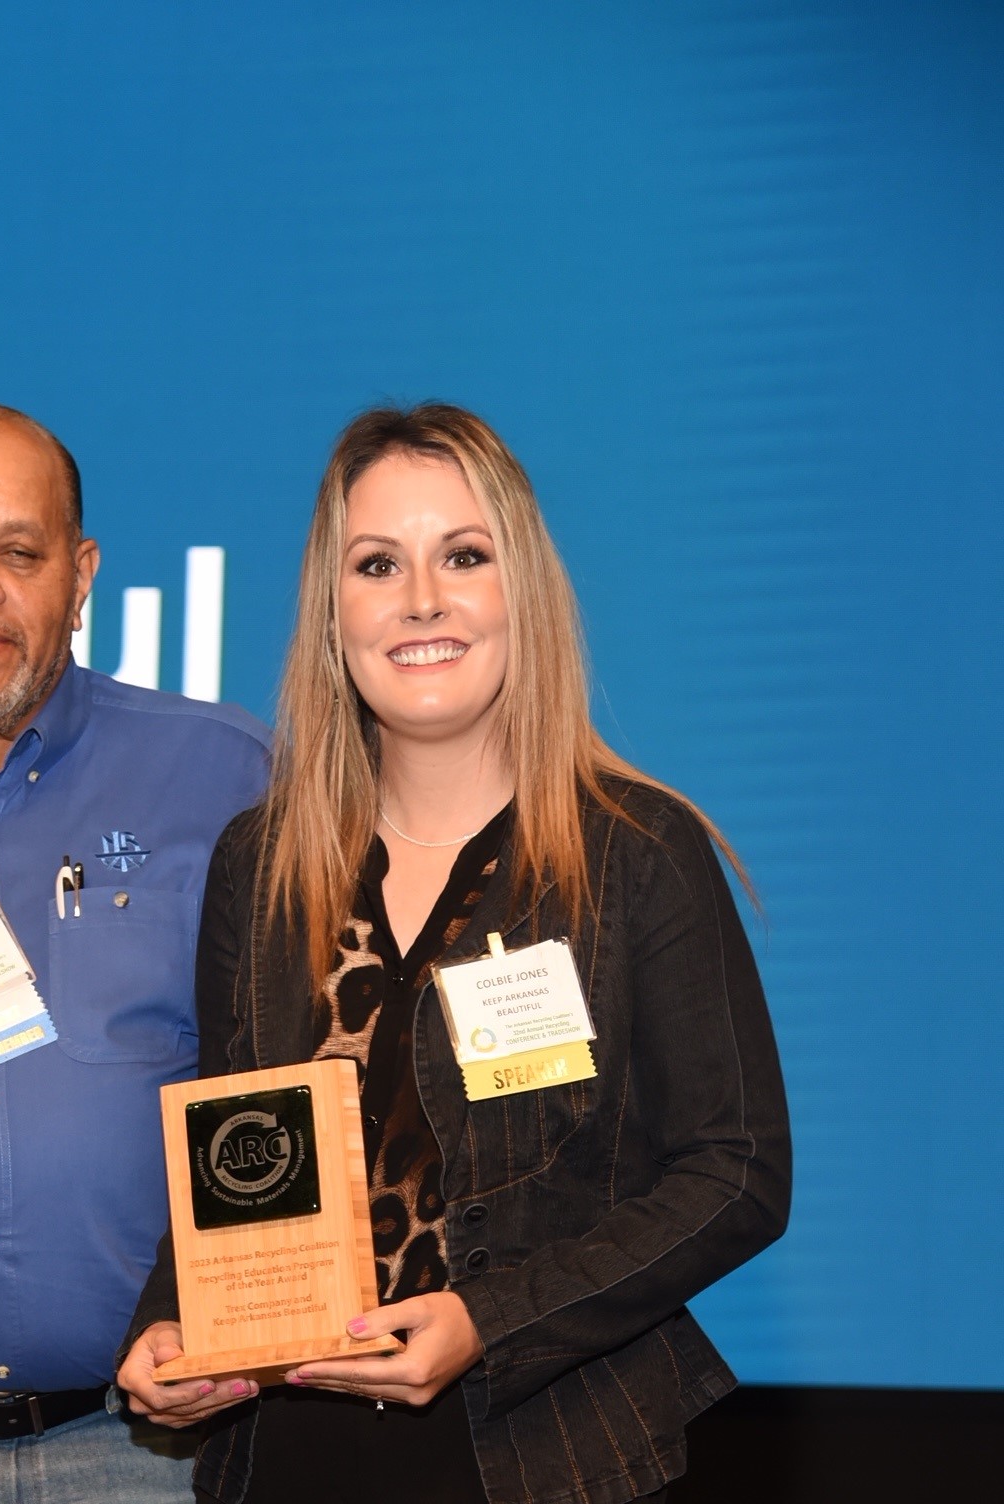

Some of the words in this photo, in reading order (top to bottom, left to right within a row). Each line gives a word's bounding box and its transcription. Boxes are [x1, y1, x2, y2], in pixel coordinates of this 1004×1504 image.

[477, 975, 513, 989] COLBIE
[516, 968, 548, 982] JONES
[483, 997, 502, 1006] KEEP
[506, 987, 549, 1002] ARKANSAS
[497, 1002, 542, 1016] BEAUTIFUL
[506, 1034, 540, 1045] CONFERENCE
[548, 1026, 580, 1037] TRADESHOW
[493, 1058, 569, 1089] SPEAKER
[230, 1115, 264, 1126] ARKANSAS
[215, 1132, 287, 1169] ARC
[197, 1146, 211, 1187] Advancing
[212, 1186, 253, 1206] Sustainable
[257, 1182, 290, 1205] Materials
[289, 1129, 305, 1180] Management
[222, 1175, 253, 1189] RECYCLING
[256, 1165, 283, 1188] COALITION
[189, 1259, 210, 1268] 2023
[213, 1254, 253, 1265] Arkansas
[255, 1248, 297, 1258] Recycling
[299, 1240, 340, 1252] Coalition
[197, 1272, 242, 1284] Recycling
[244, 1265, 291, 1277] Education
[293, 1258, 334, 1270] Program
[226, 1283, 235, 1291] of
[238, 1281, 252, 1289] the
[255, 1277, 274, 1287] Year
[277, 1272, 307, 1283] Award
[248, 1298, 291, 1311] Company
[294, 1293, 312, 1304] and
[213, 1317, 237, 1326] Keep
[239, 1311, 281, 1322] Arkansas
[284, 1303, 327, 1316] Beautiful
